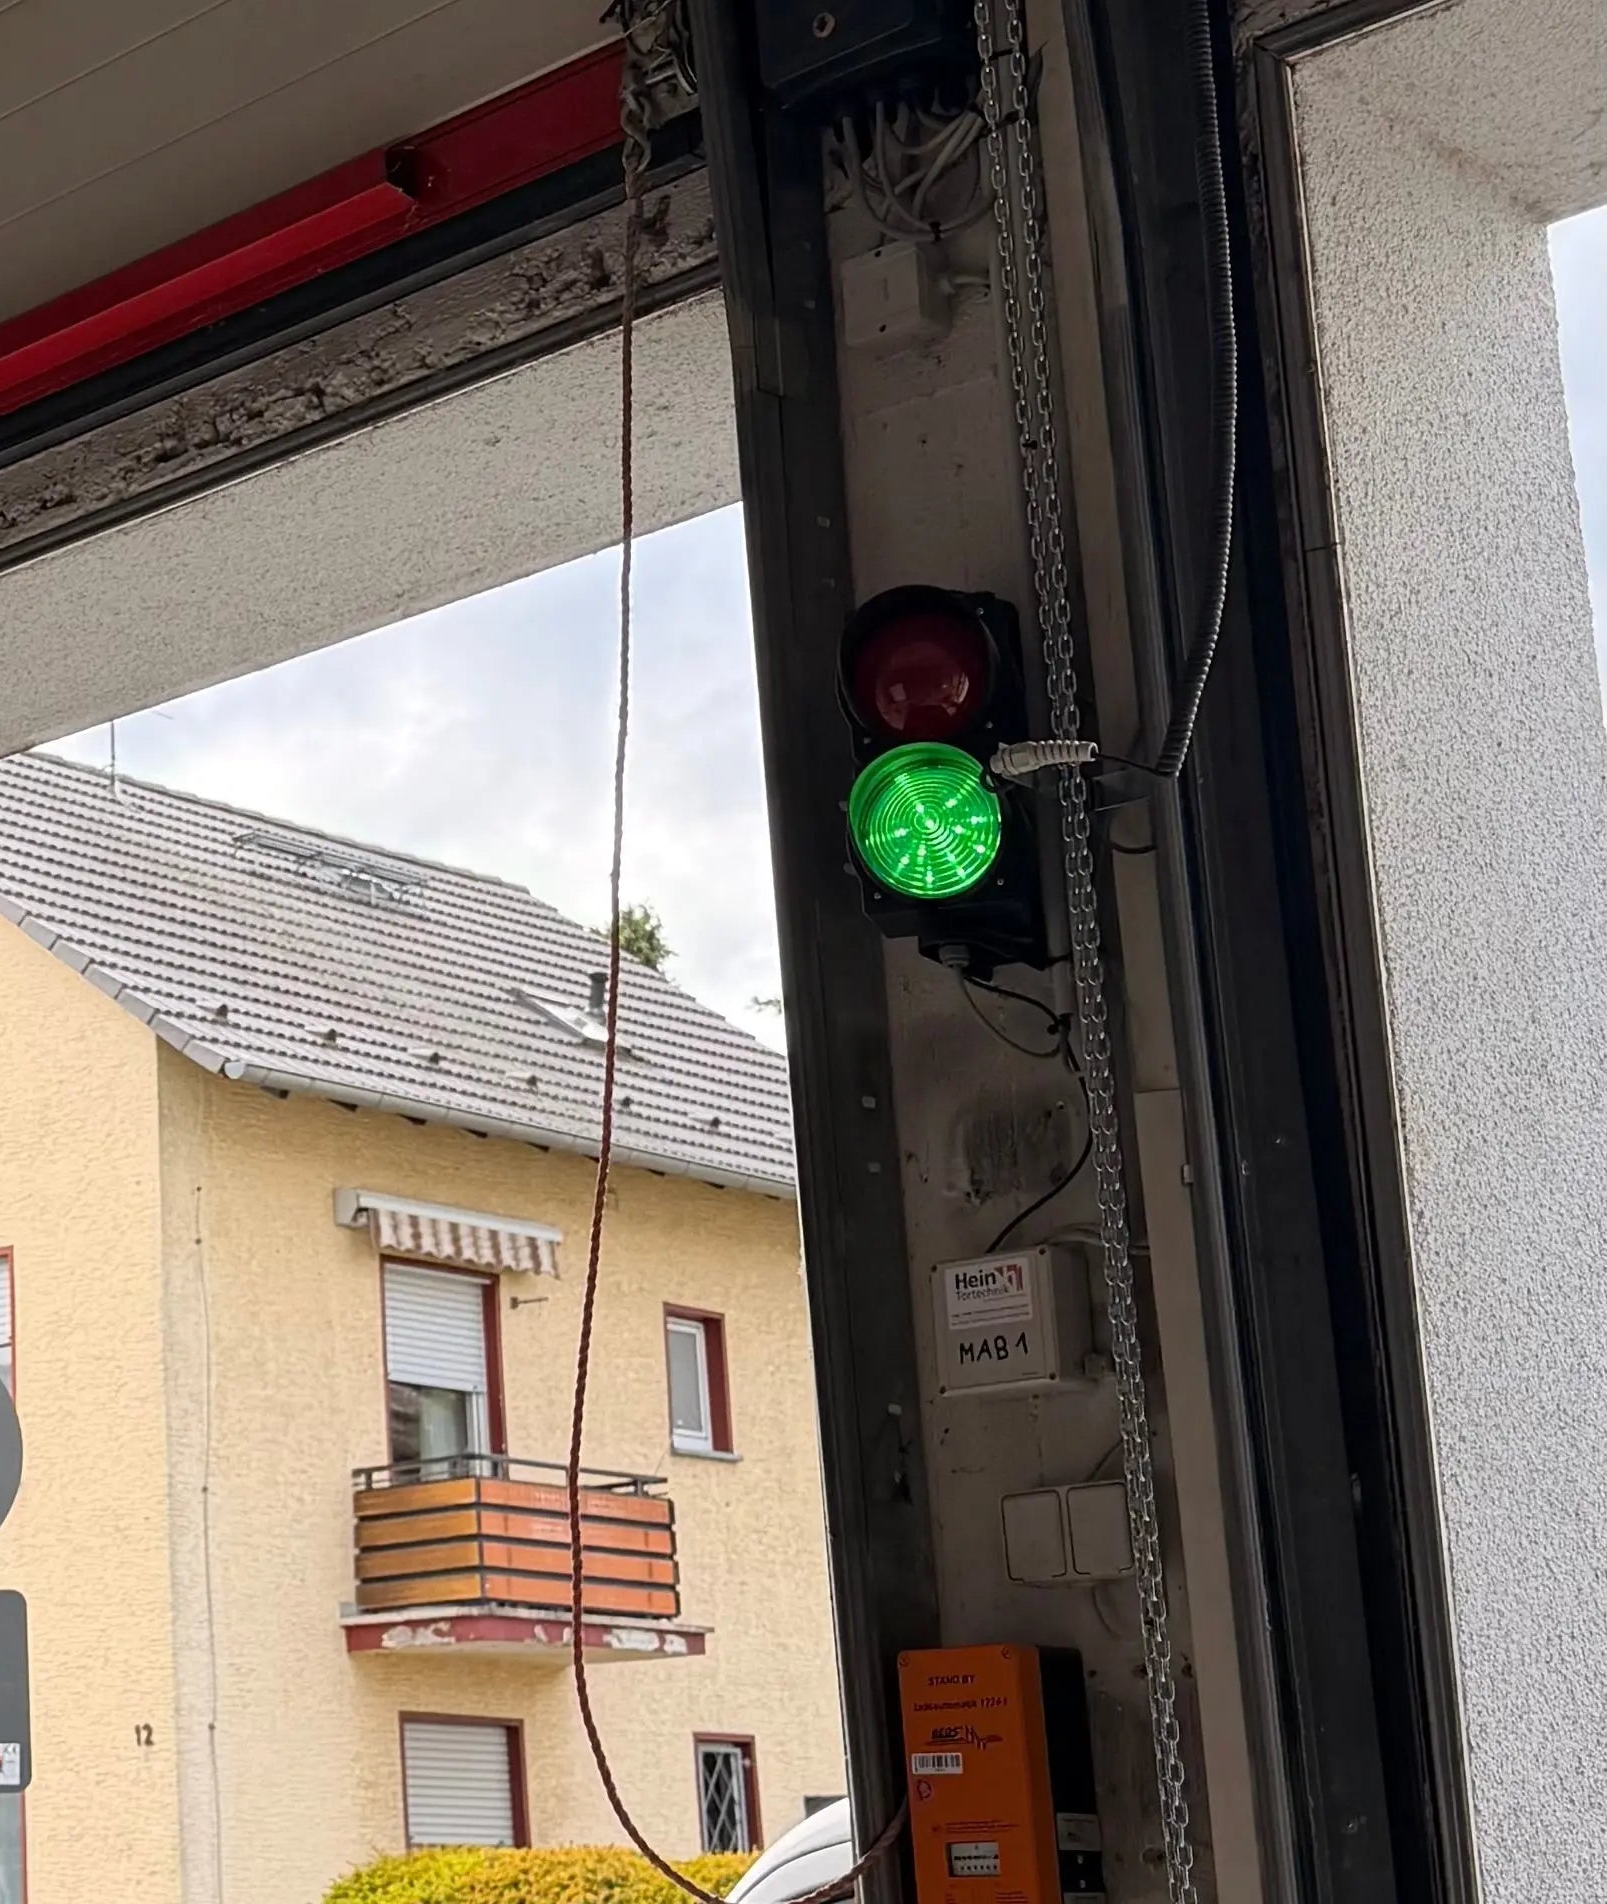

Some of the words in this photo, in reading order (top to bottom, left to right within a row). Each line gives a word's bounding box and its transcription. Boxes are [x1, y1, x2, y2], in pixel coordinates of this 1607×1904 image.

[955, 1270, 996, 1290] Hein
[959, 1335, 1009, 1365] MAB
[1015, 1332, 1028, 1354] 1
[135, 1723, 154, 1747] 12
